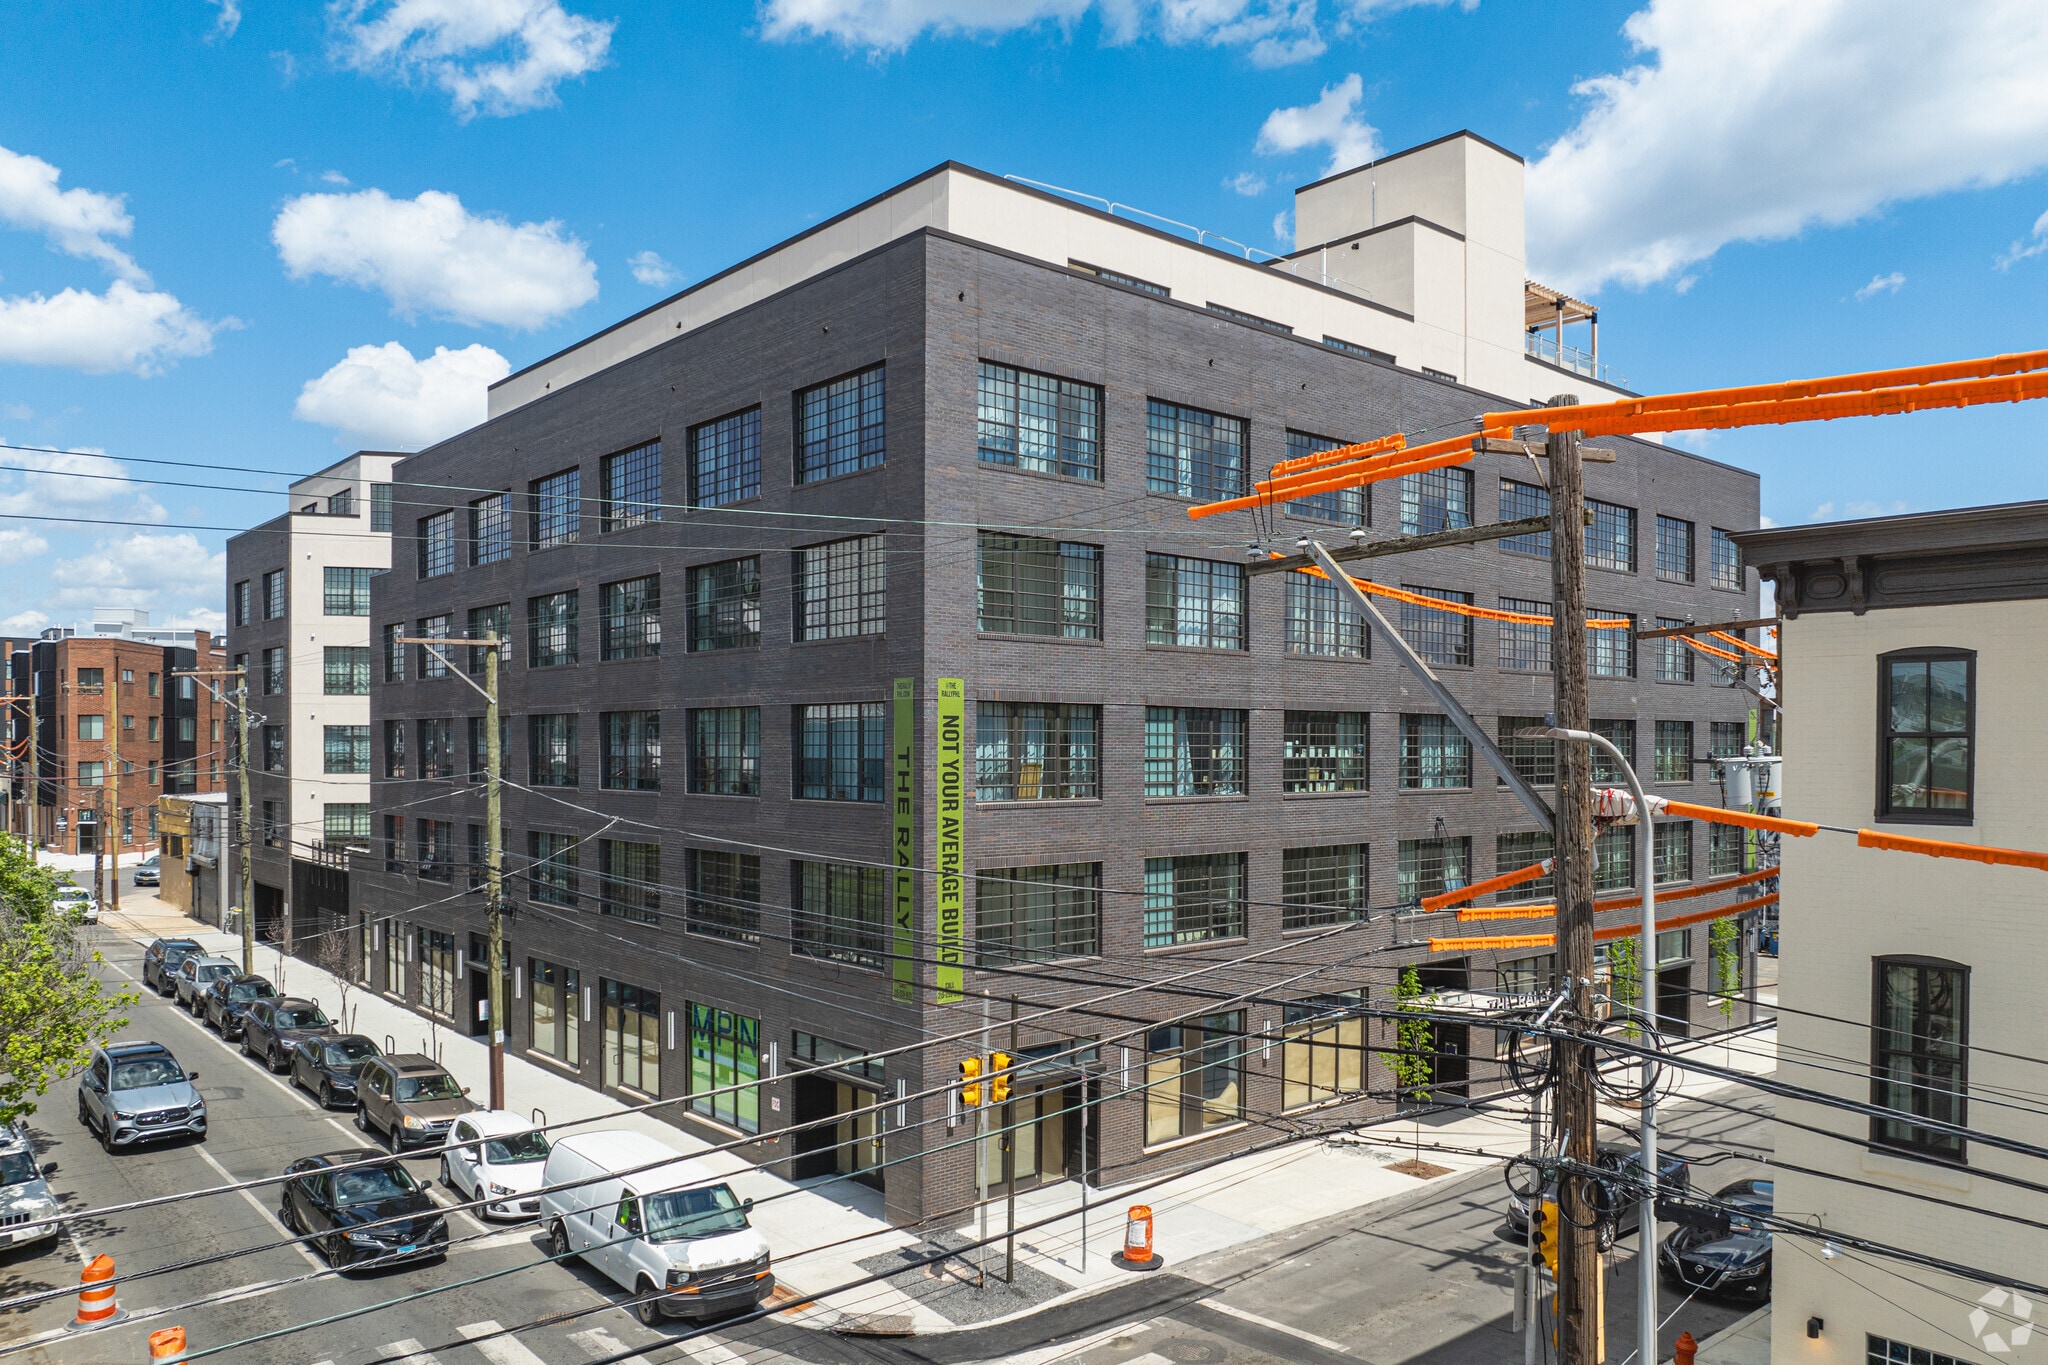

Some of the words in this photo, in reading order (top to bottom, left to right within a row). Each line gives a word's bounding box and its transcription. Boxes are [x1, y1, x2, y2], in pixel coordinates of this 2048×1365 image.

[942, 715, 960, 754] NOT
[898, 746, 910, 815] THE
[942, 759, 960, 812] YOUR
[897, 827, 910, 933] RALLY
[942, 817, 959, 903] AVERAGE
[693, 1004, 757, 1058] MPN
